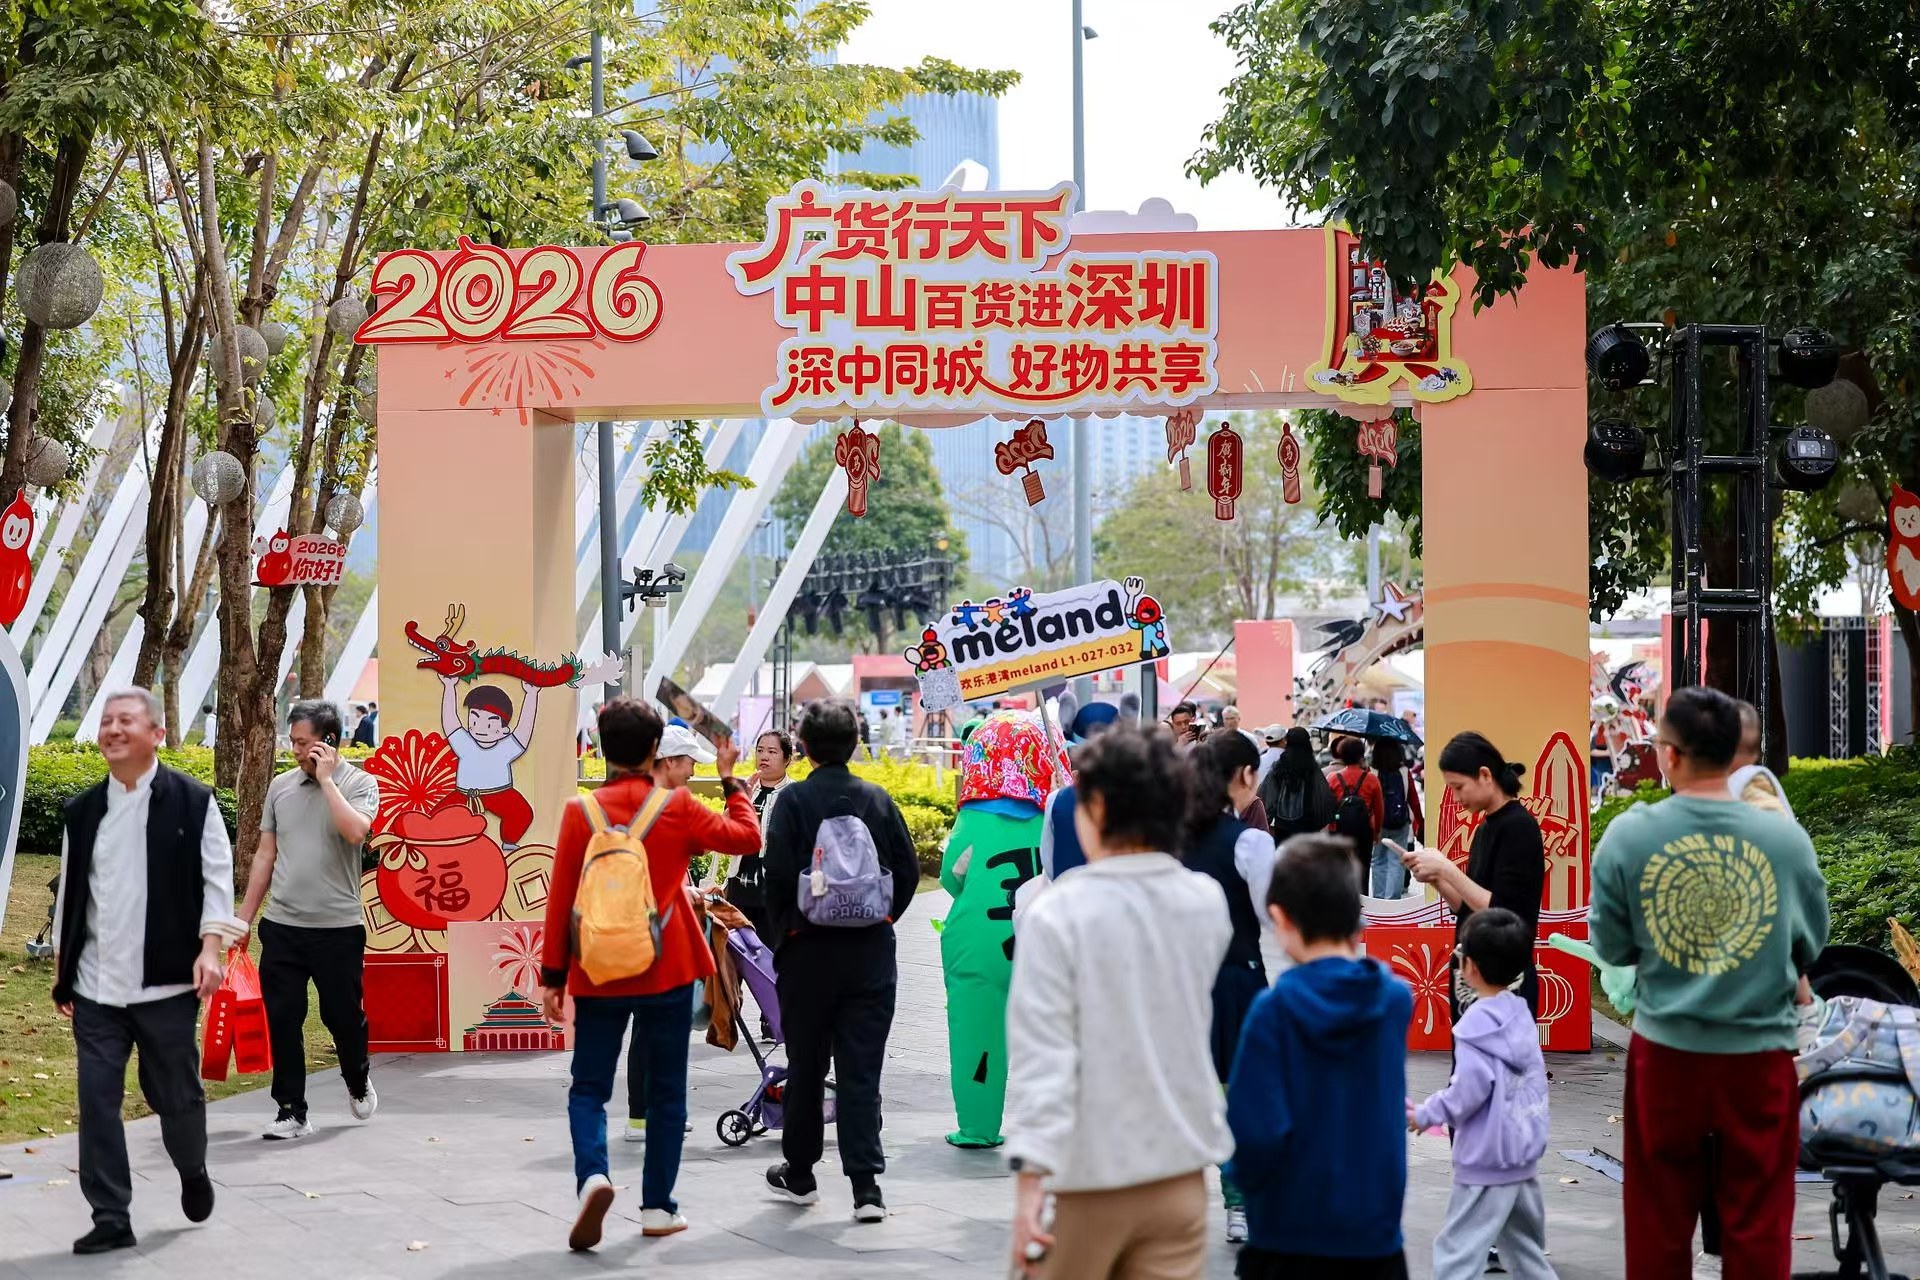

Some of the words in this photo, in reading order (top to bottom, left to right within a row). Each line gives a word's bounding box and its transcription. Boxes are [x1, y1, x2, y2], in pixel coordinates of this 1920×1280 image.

[737, 190, 1064, 282] 广货行天下
[354, 238, 663, 343] 2026
[785, 262, 1205, 332] 中山百货进深圳
[771, 340, 987, 406] 深中同城
[1008, 342, 1205, 394] 好物共享
[297, 541, 337, 555] 2026
[951, 589, 1124, 663] meland
[414, 861, 470, 913] 福
